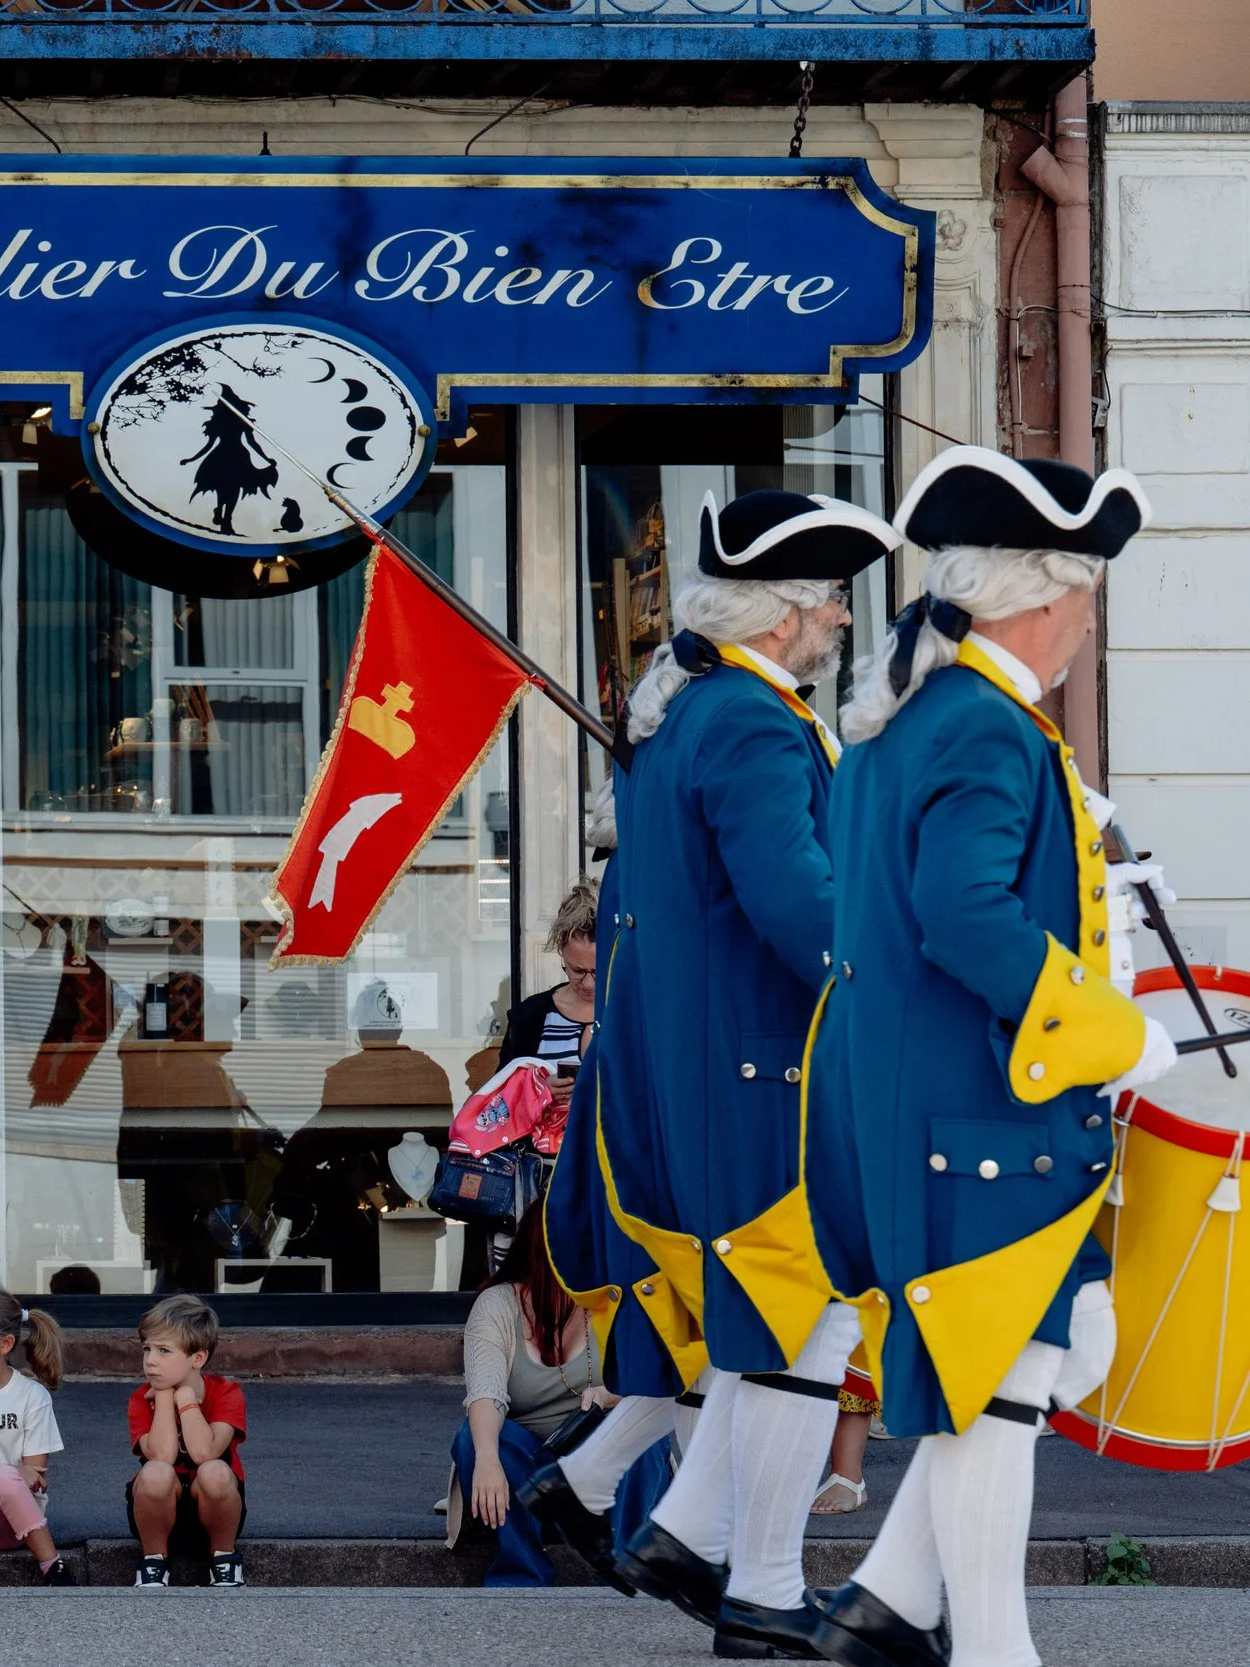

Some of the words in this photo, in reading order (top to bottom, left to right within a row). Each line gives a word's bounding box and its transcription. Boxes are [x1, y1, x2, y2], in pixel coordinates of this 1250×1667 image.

[163, 225, 340, 299] Du
[354, 228, 613, 307] Bien
[638, 237, 849, 314] Etre
